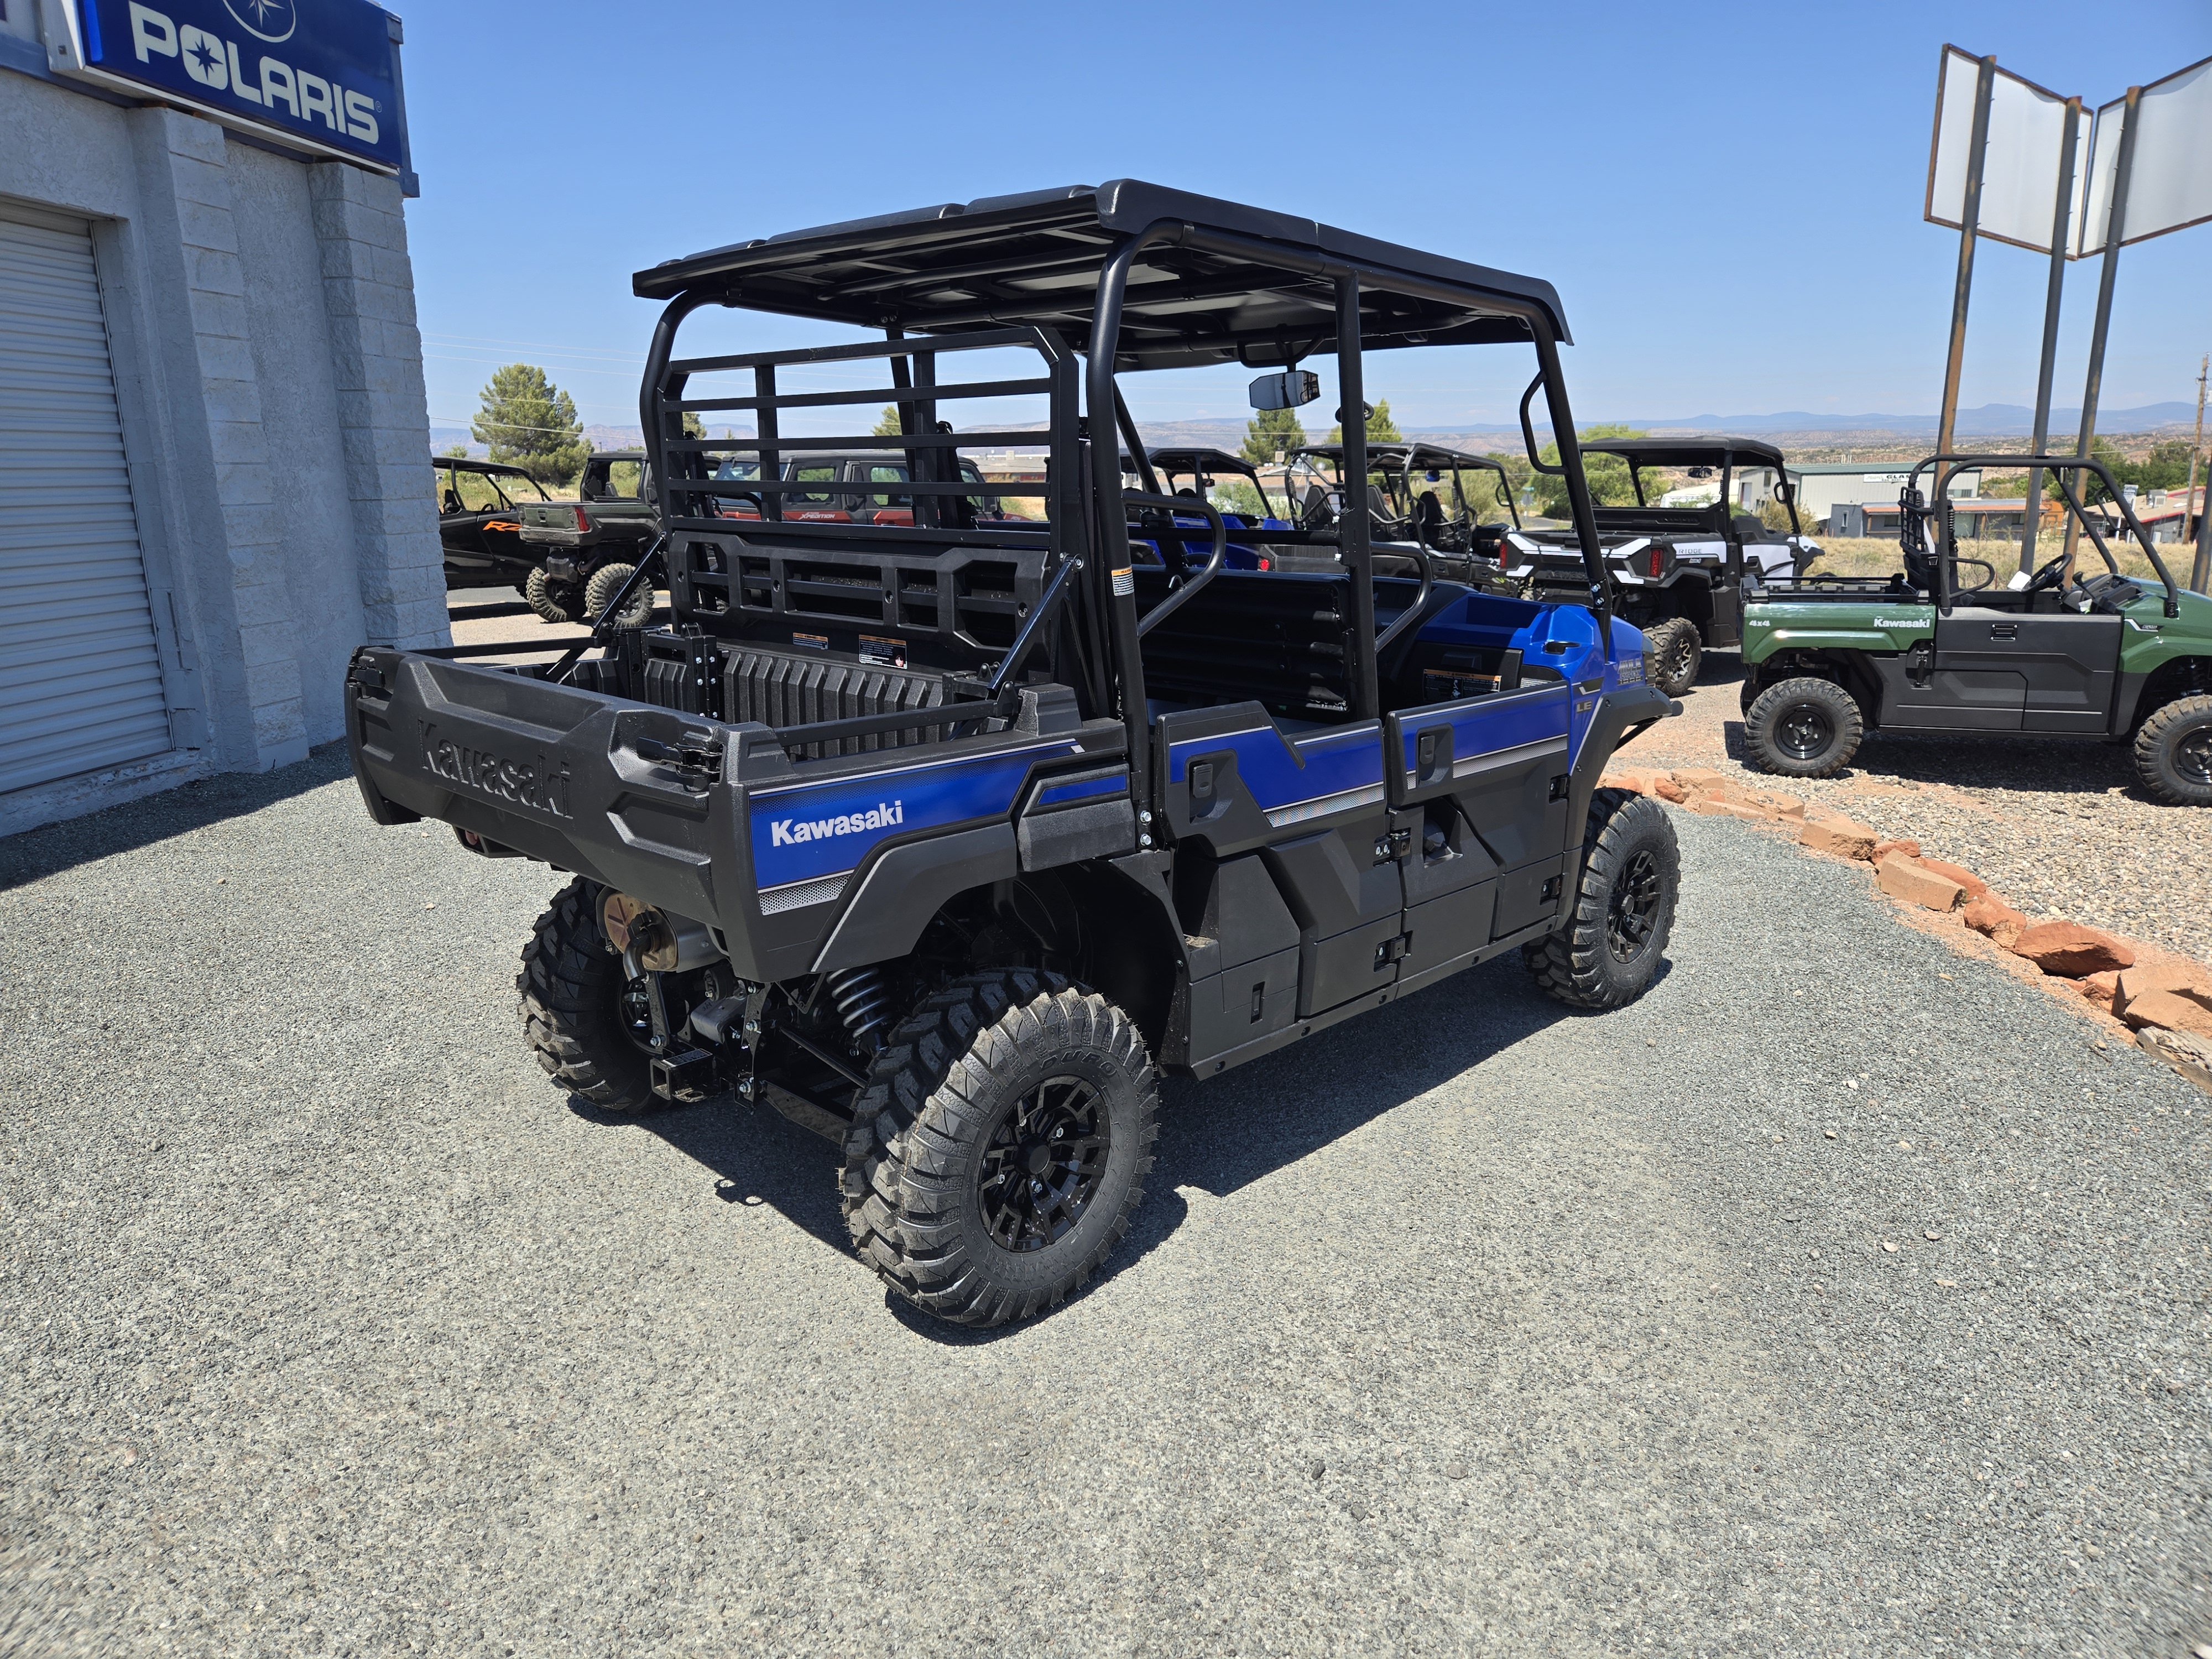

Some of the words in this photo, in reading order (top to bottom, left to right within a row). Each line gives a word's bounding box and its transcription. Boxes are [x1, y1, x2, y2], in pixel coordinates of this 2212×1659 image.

[128, 1, 379, 145] POLARIS
[483, 521, 521, 531] RZ
[1874, 618, 1931, 628] Kawasaki
[1577, 701, 1592, 712] LE
[418, 718, 573, 820] Kawasaki
[771, 800, 904, 847] Kawasaki
[1040, 1049, 1118, 1076] DURO
